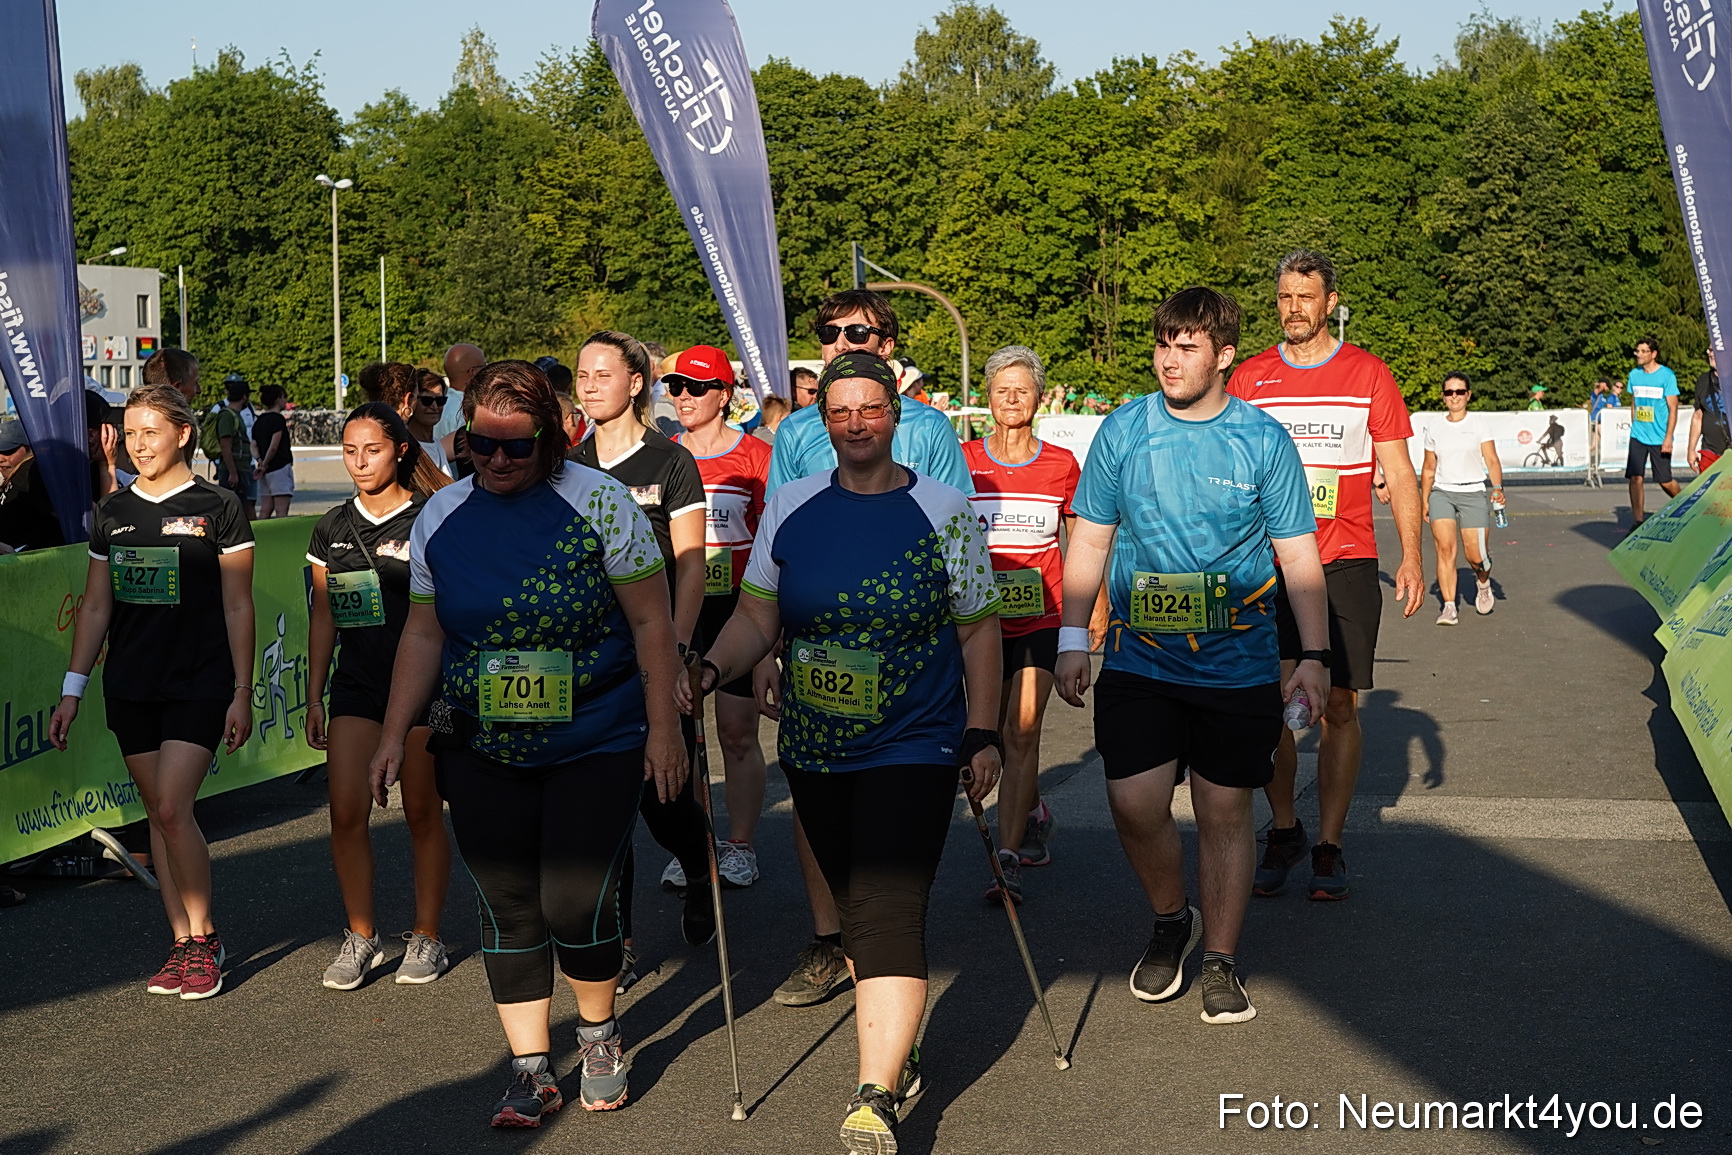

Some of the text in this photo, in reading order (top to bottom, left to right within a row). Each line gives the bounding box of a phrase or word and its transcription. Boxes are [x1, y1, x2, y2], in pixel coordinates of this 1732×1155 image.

[1222, 479, 1257, 491] PLAST
[1327, 488, 1335, 511] 2022
[992, 512, 1046, 528] Petry
[123, 567, 160, 586] 427
[168, 570, 176, 596] 2022
[138, 586, 165, 594] Sabrina
[348, 609, 373, 618] Fiorella
[370, 591, 381, 617] 2022
[1141, 593, 1192, 613] 1924
[1194, 596, 1202, 624] 2022
[1143, 614, 1166, 622] Harant
[500, 675, 545, 699] 701
[796, 665, 805, 696] WALK
[810, 668, 854, 696] 682
[483, 678, 492, 712] WALK
[498, 700, 551, 709] Lahse Anett
[558, 679, 567, 711] 2022
[806, 688, 837, 703] Altmann
[838, 696, 860, 706] Heidi
[865, 679, 873, 710] 2022
